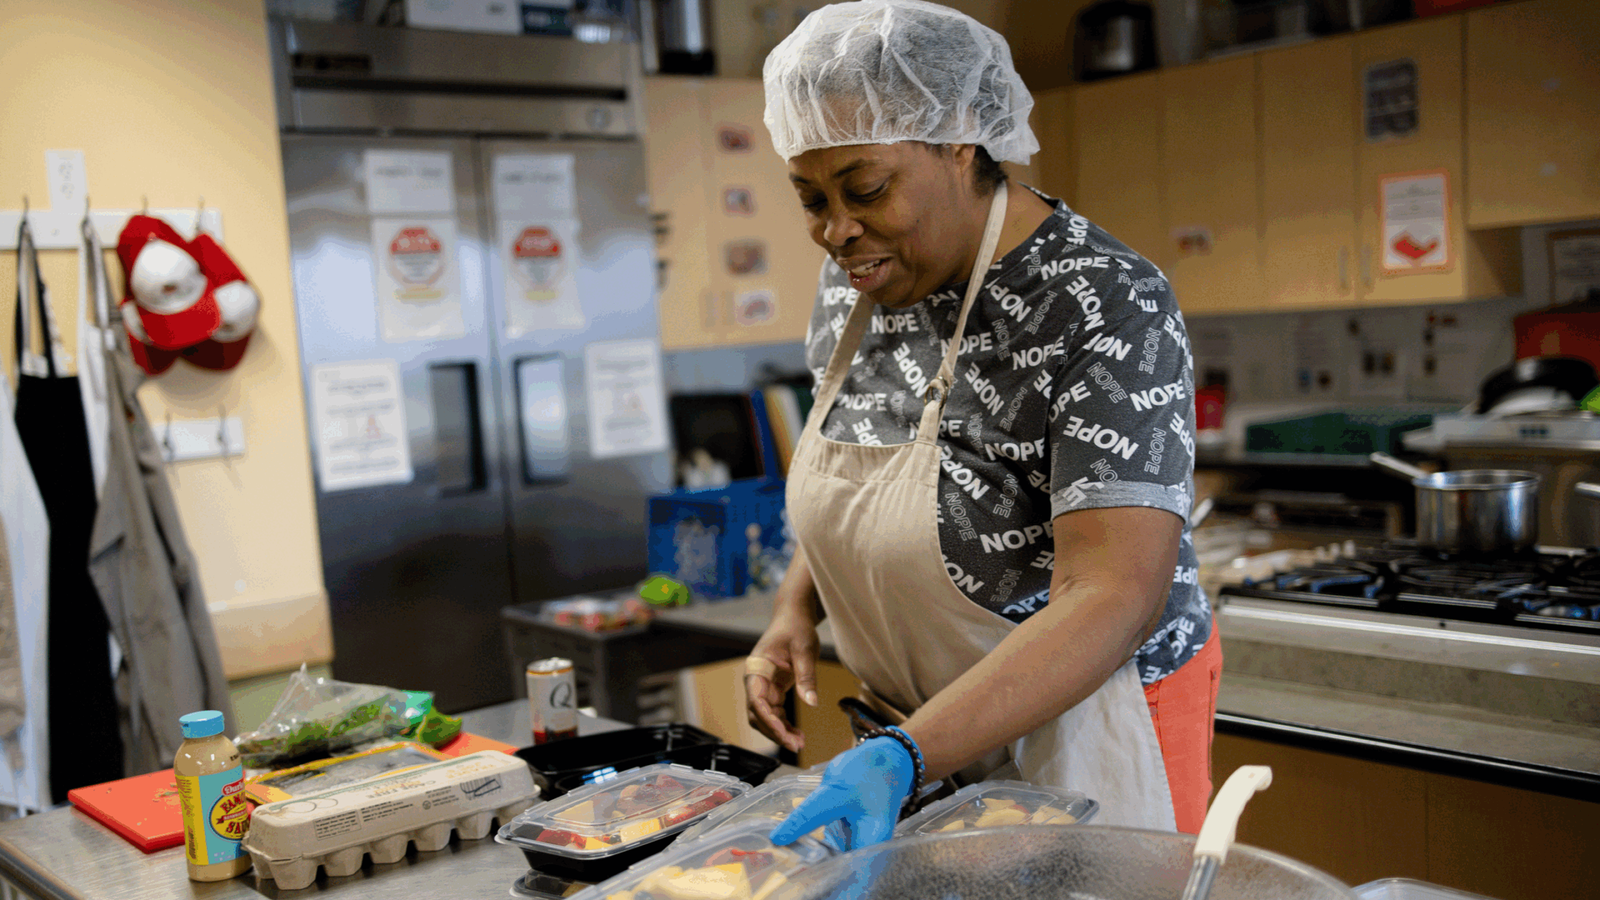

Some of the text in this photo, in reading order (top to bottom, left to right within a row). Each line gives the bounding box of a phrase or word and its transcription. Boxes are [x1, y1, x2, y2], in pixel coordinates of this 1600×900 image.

[1040, 256, 1111, 281] NOPE
[985, 277, 1032, 322] NOP
[1024, 290, 1058, 335] NOPE
[871, 313, 920, 335] NOPE
[893, 341, 930, 398] NOPE
[1012, 335, 1066, 371] NOPE
[1139, 327, 1161, 375] NOPE
[838, 392, 887, 411] NOPE
[965, 362, 1005, 416] NOPE
[1049, 380, 1092, 423] OPE
[1086, 362, 1128, 404] NOPE
[1129, 379, 1186, 412] NOPE
[909, 419, 963, 440] NPE
[999, 386, 1028, 432] NOPE
[1063, 415, 1139, 460] NOPE
[1144, 427, 1166, 475] NOPE
[1090, 458, 1122, 483] NO
[945, 491, 978, 542] NOPE
[992, 473, 1019, 519] NOPE
[943, 554, 985, 594] NO
